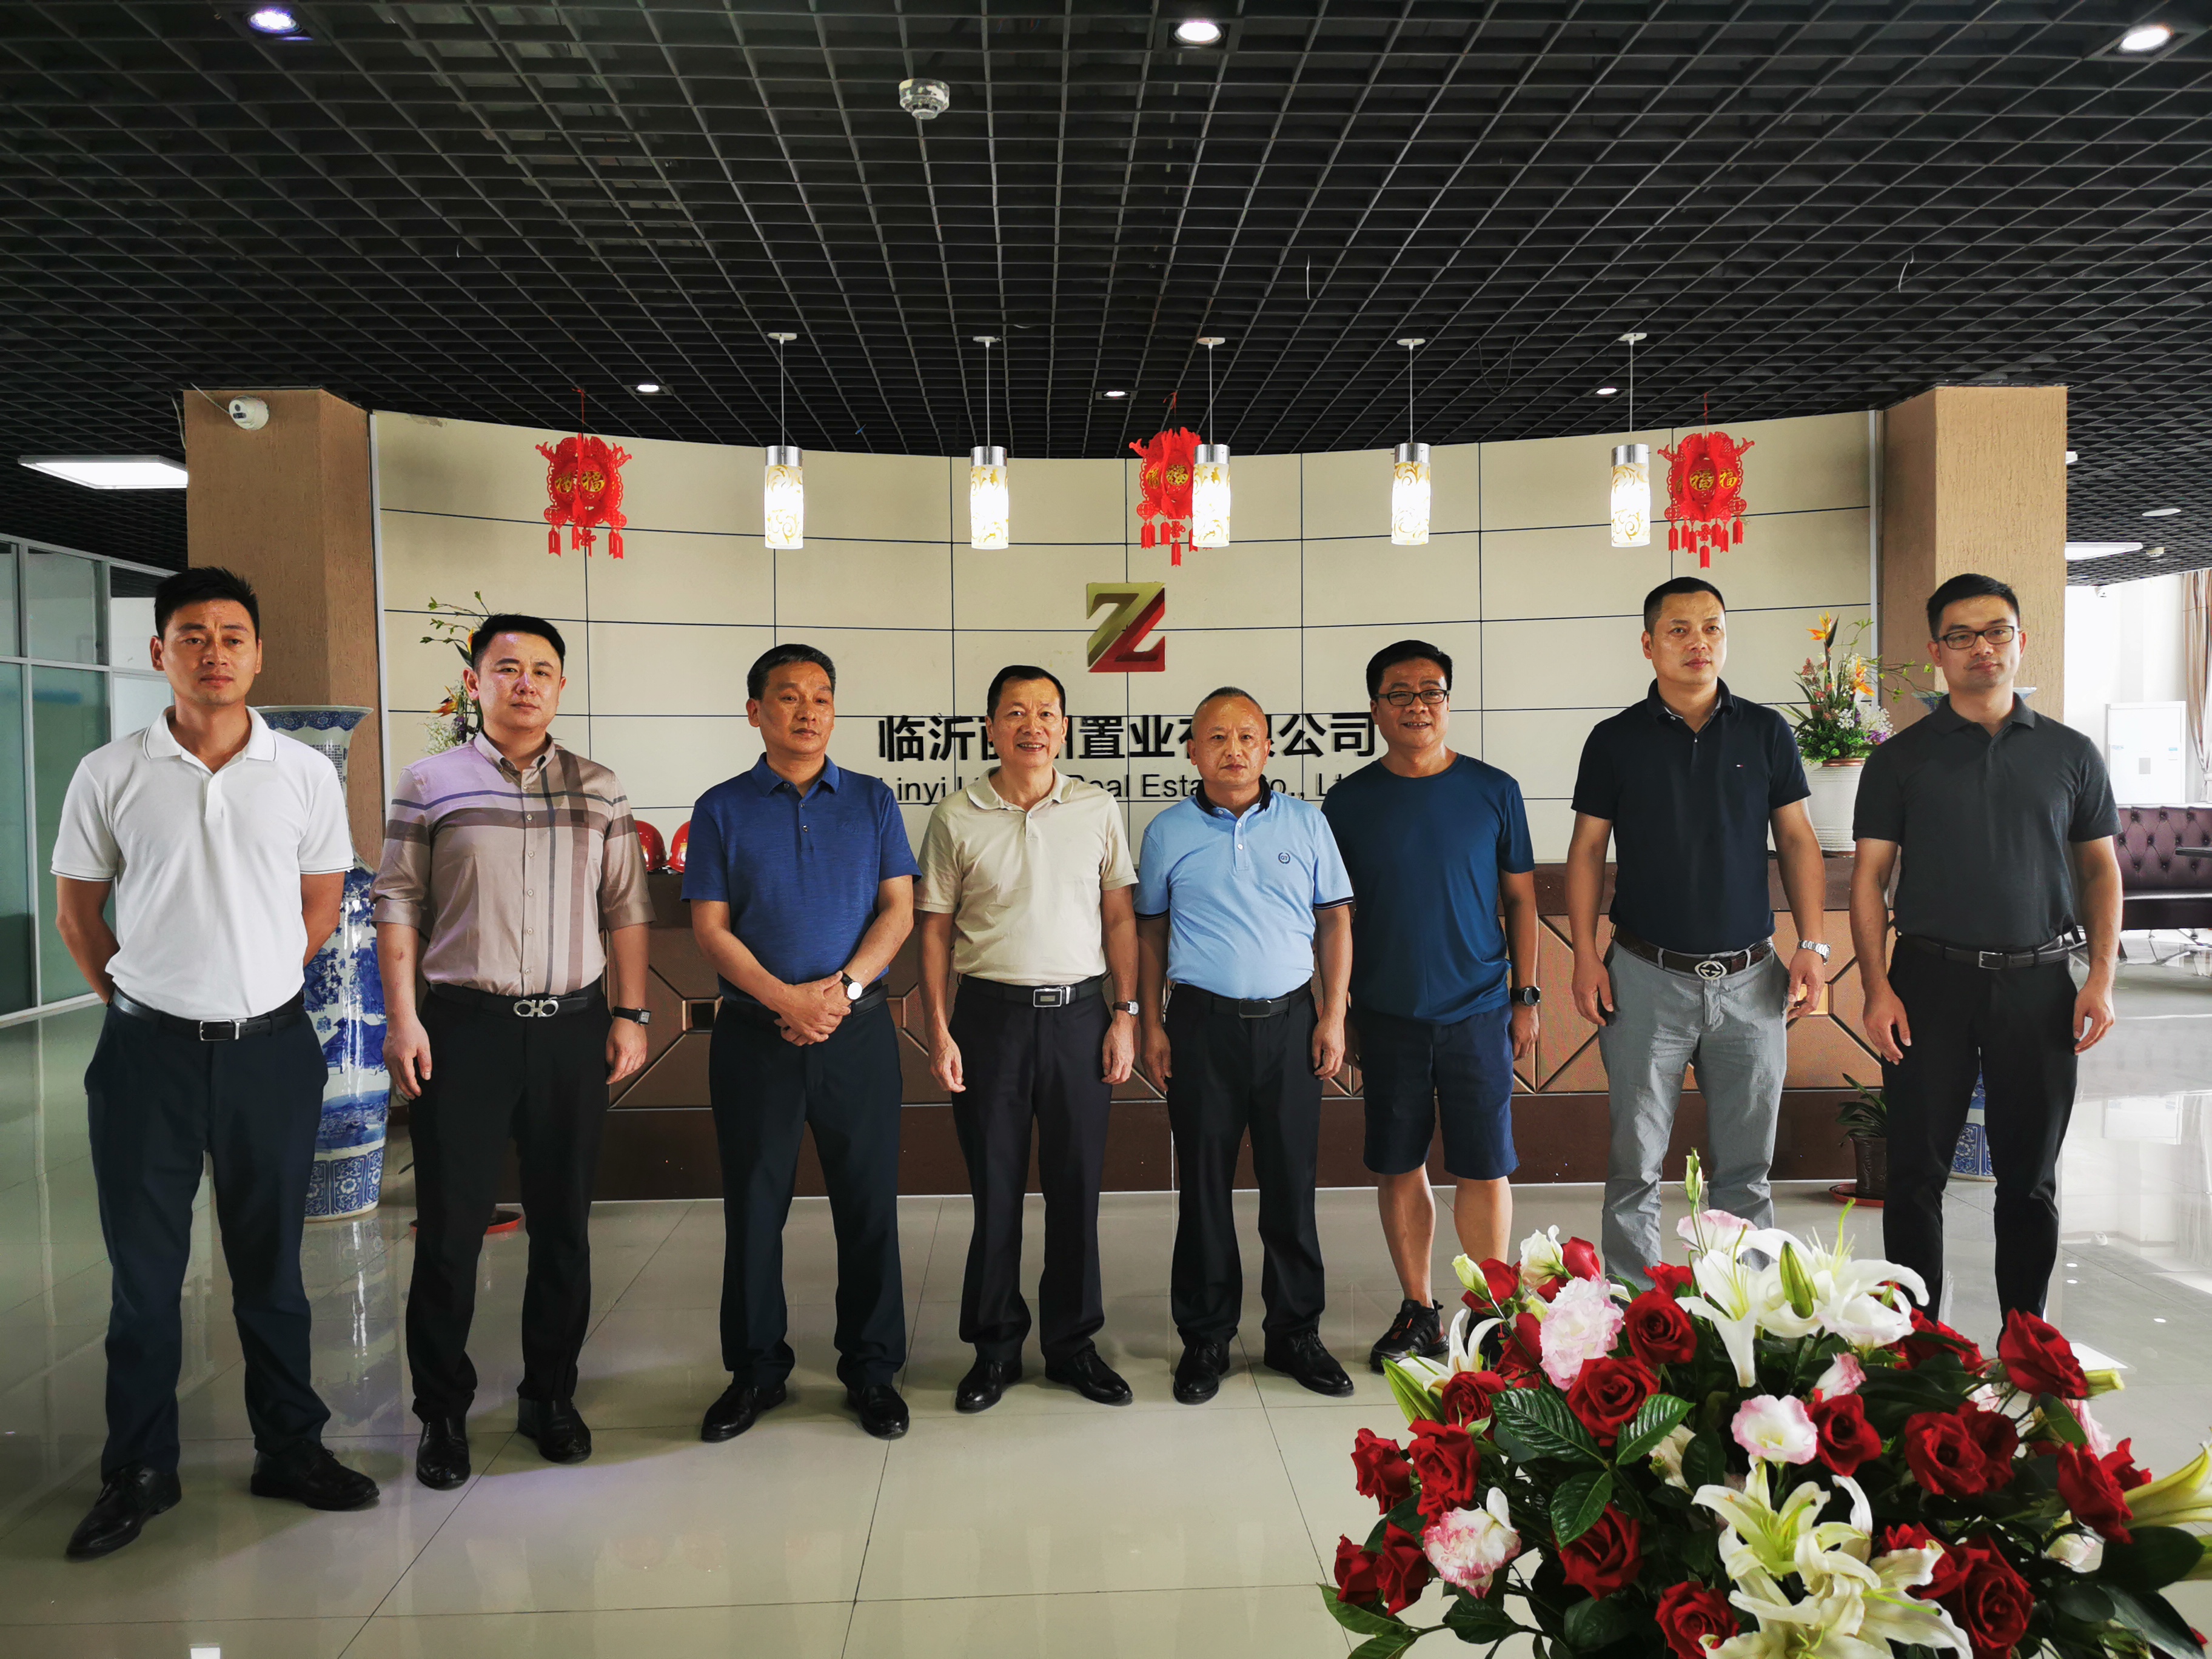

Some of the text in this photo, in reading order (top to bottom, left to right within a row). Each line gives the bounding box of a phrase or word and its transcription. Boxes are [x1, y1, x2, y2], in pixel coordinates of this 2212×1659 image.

[878, 712, 1375, 762] 临沂置业公司
[879, 777, 946, 806] inyi
[1065, 774, 1129, 797] al
[1142, 774, 1203, 797] Esta
[1270, 779, 1304, 800] o.,
